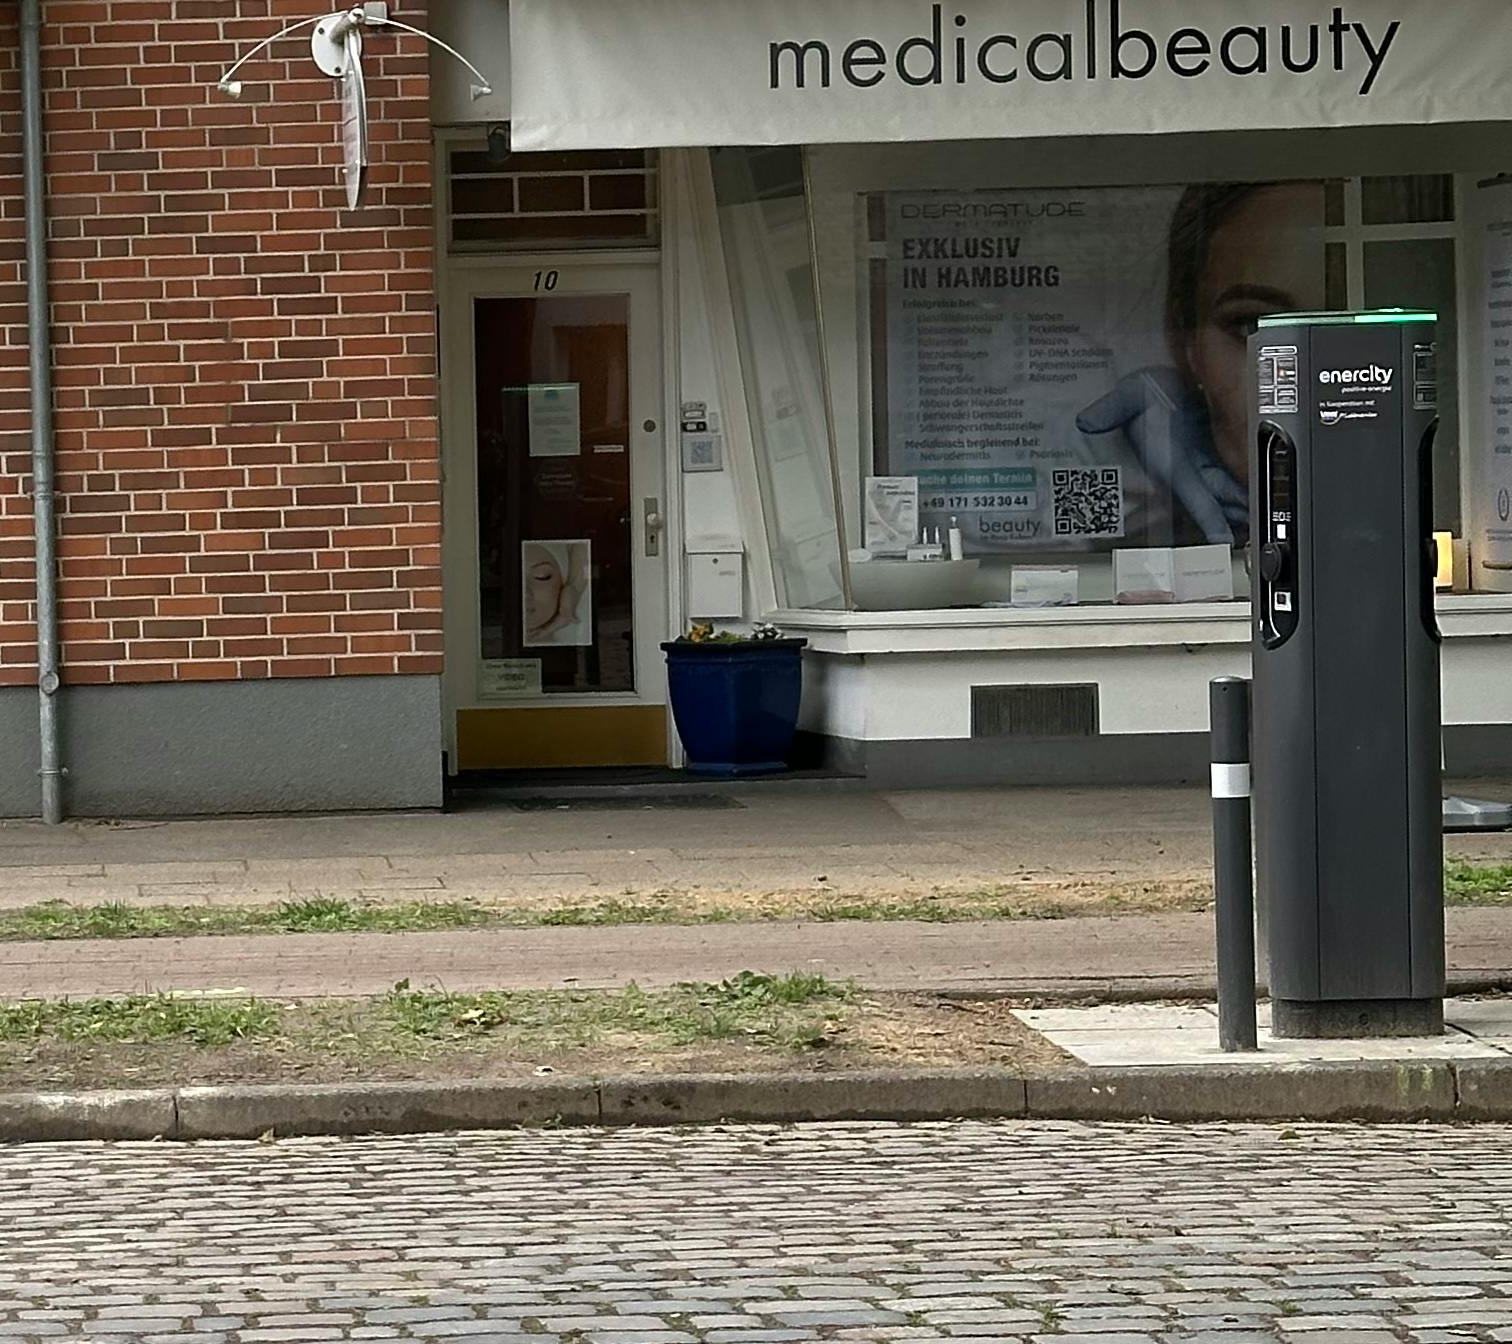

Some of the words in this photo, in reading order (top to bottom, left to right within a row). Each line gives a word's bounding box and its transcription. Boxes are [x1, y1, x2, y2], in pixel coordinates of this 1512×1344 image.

[900, 202, 1086, 219] DERMATUDE
[902, 237, 1021, 260] EXKLUSIV
[533, 270, 558, 291] 10
[903, 267, 927, 289] IN
[937, 264, 1061, 289] HAMBURG
[1319, 364, 1393, 384] enercity
[952, 398, 970, 408] der
[950, 473, 990, 484] deinen
[993, 472, 1033, 484] Termin
[923, 497, 945, 508] +49
[949, 496, 969, 508] 171
[979, 515, 1041, 537] beauty
